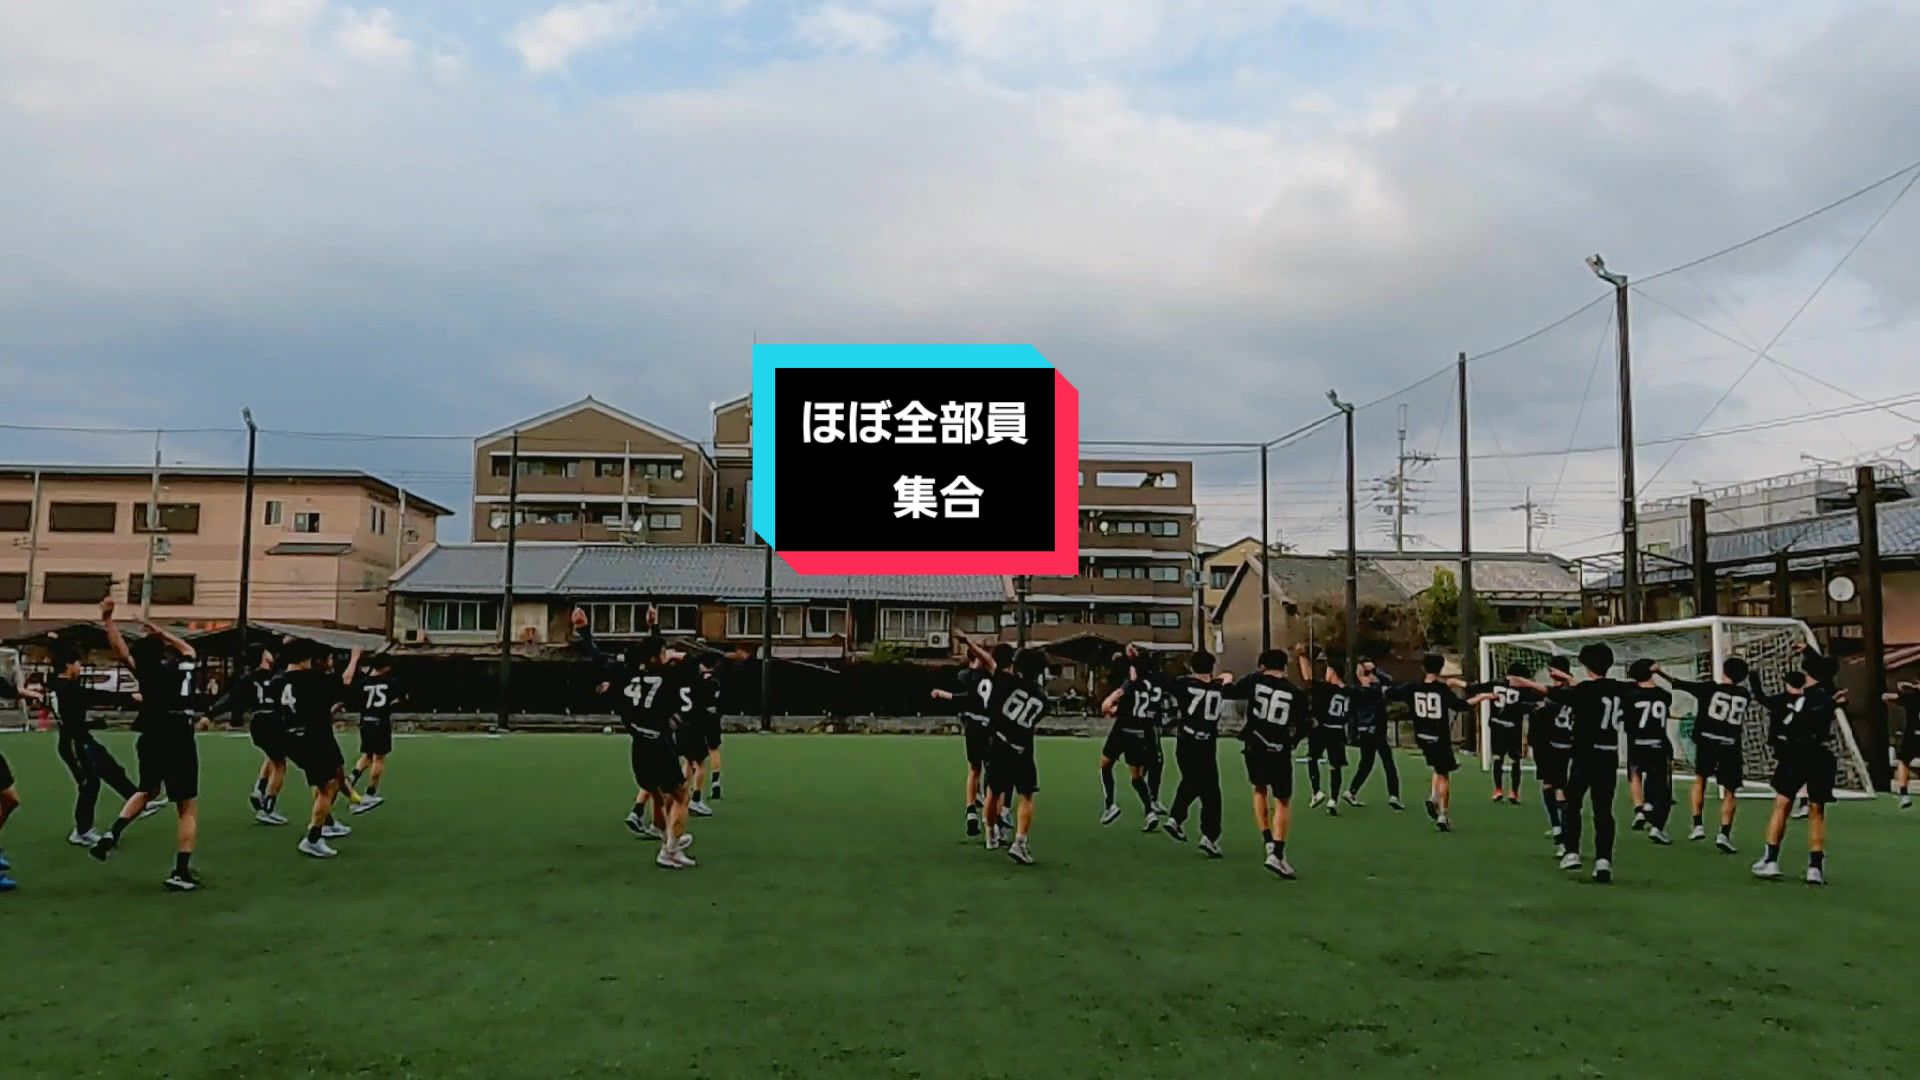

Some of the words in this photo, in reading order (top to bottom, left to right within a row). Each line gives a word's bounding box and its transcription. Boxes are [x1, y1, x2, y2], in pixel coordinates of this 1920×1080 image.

[363, 683, 389, 709] 75
[623, 676, 663, 709] 47
[1002, 689, 1044, 729] 60
[1187, 686, 1222, 721] 70
[1252, 683, 1293, 725] 56
[1414, 691, 1442, 719] 69
[1707, 690, 1748, 725] 68
[1634, 700, 1666, 729] 79
